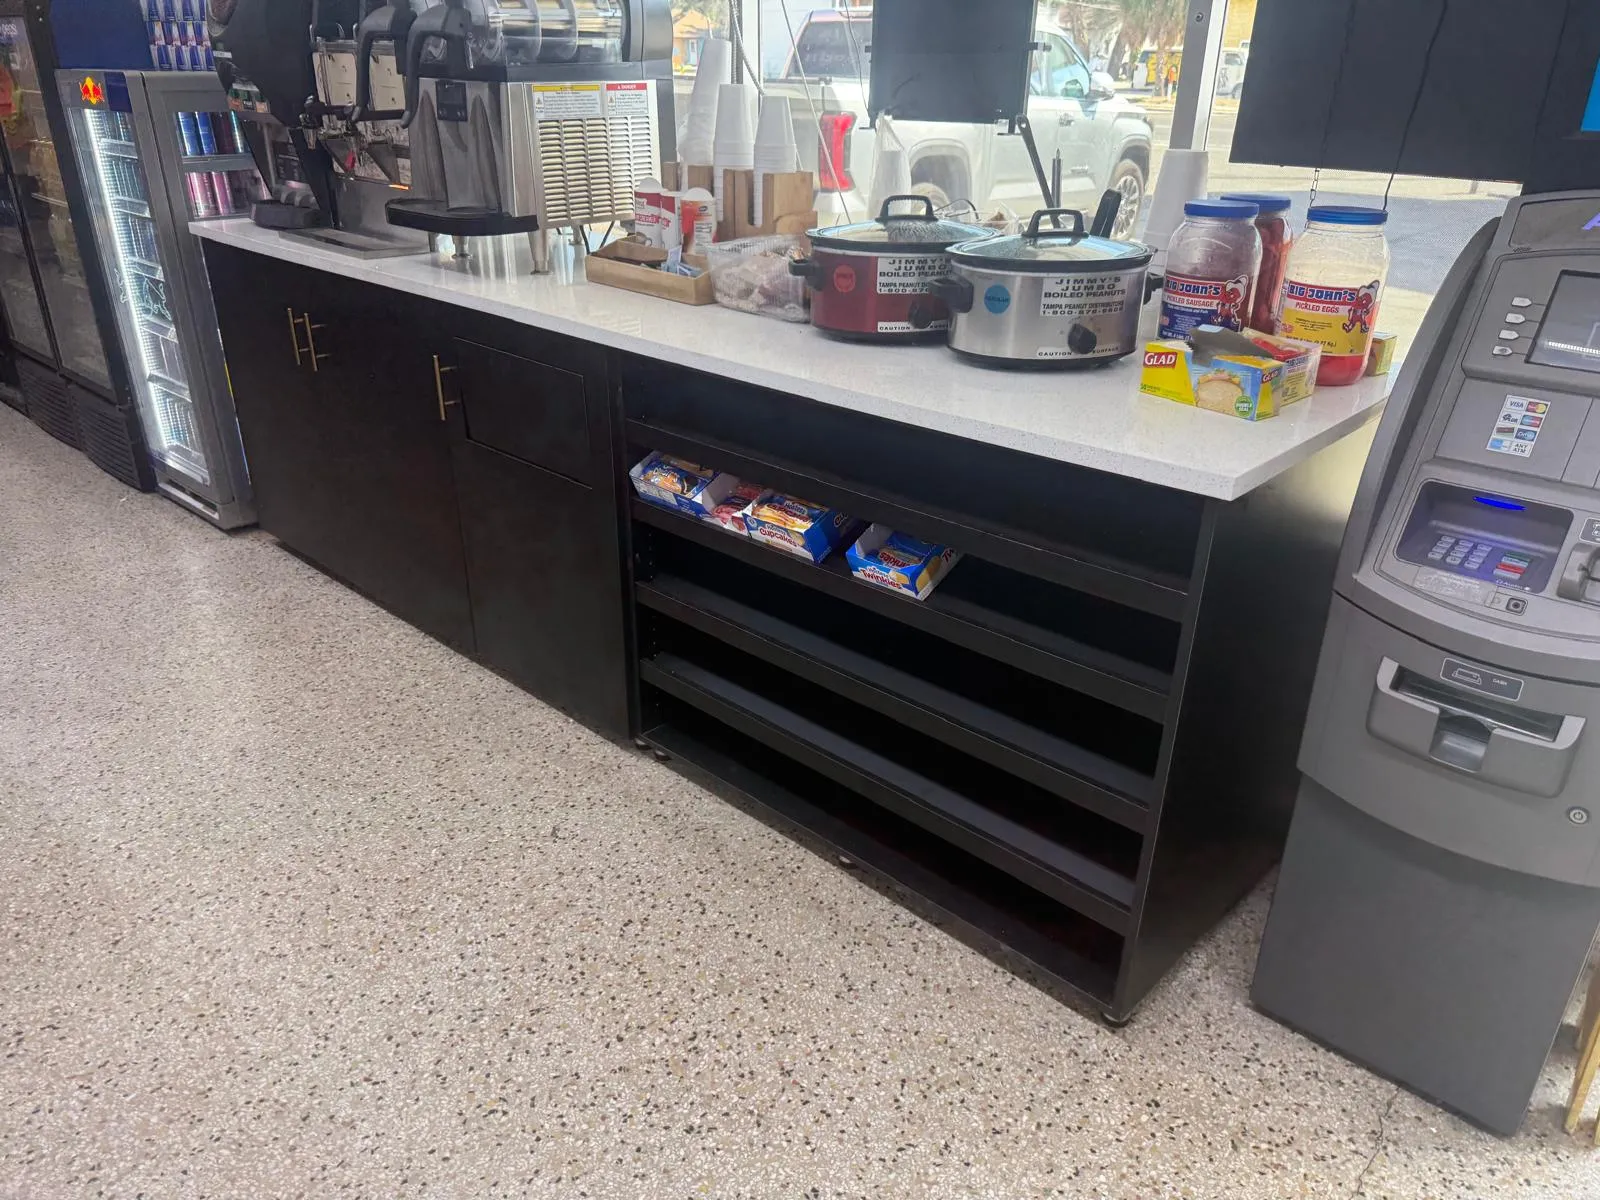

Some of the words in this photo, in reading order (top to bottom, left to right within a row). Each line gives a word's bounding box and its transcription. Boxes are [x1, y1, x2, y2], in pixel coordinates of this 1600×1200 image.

[894, 264, 947, 272] JUMBO
[1055, 276, 1121, 285] JIMMY'S
[1061, 283, 1116, 292] JUMBO
[1179, 282, 1221, 296] JOHN'S
[1288, 283, 1306, 297] BIG
[1307, 287, 1357, 303] JOHN'S
[1044, 291, 1084, 299] BOILED
[1085, 288, 1126, 298] PEANUTS
[1064, 302, 1087, 310] PEANUT
[1186, 298, 1214, 308] SAUSAGE
[1295, 301, 1321, 312] PICKLED
[1321, 305, 1340, 314] EGGS
[1144, 352, 1177, 366] GLAD
[860, 568, 903, 591] Twinkies
